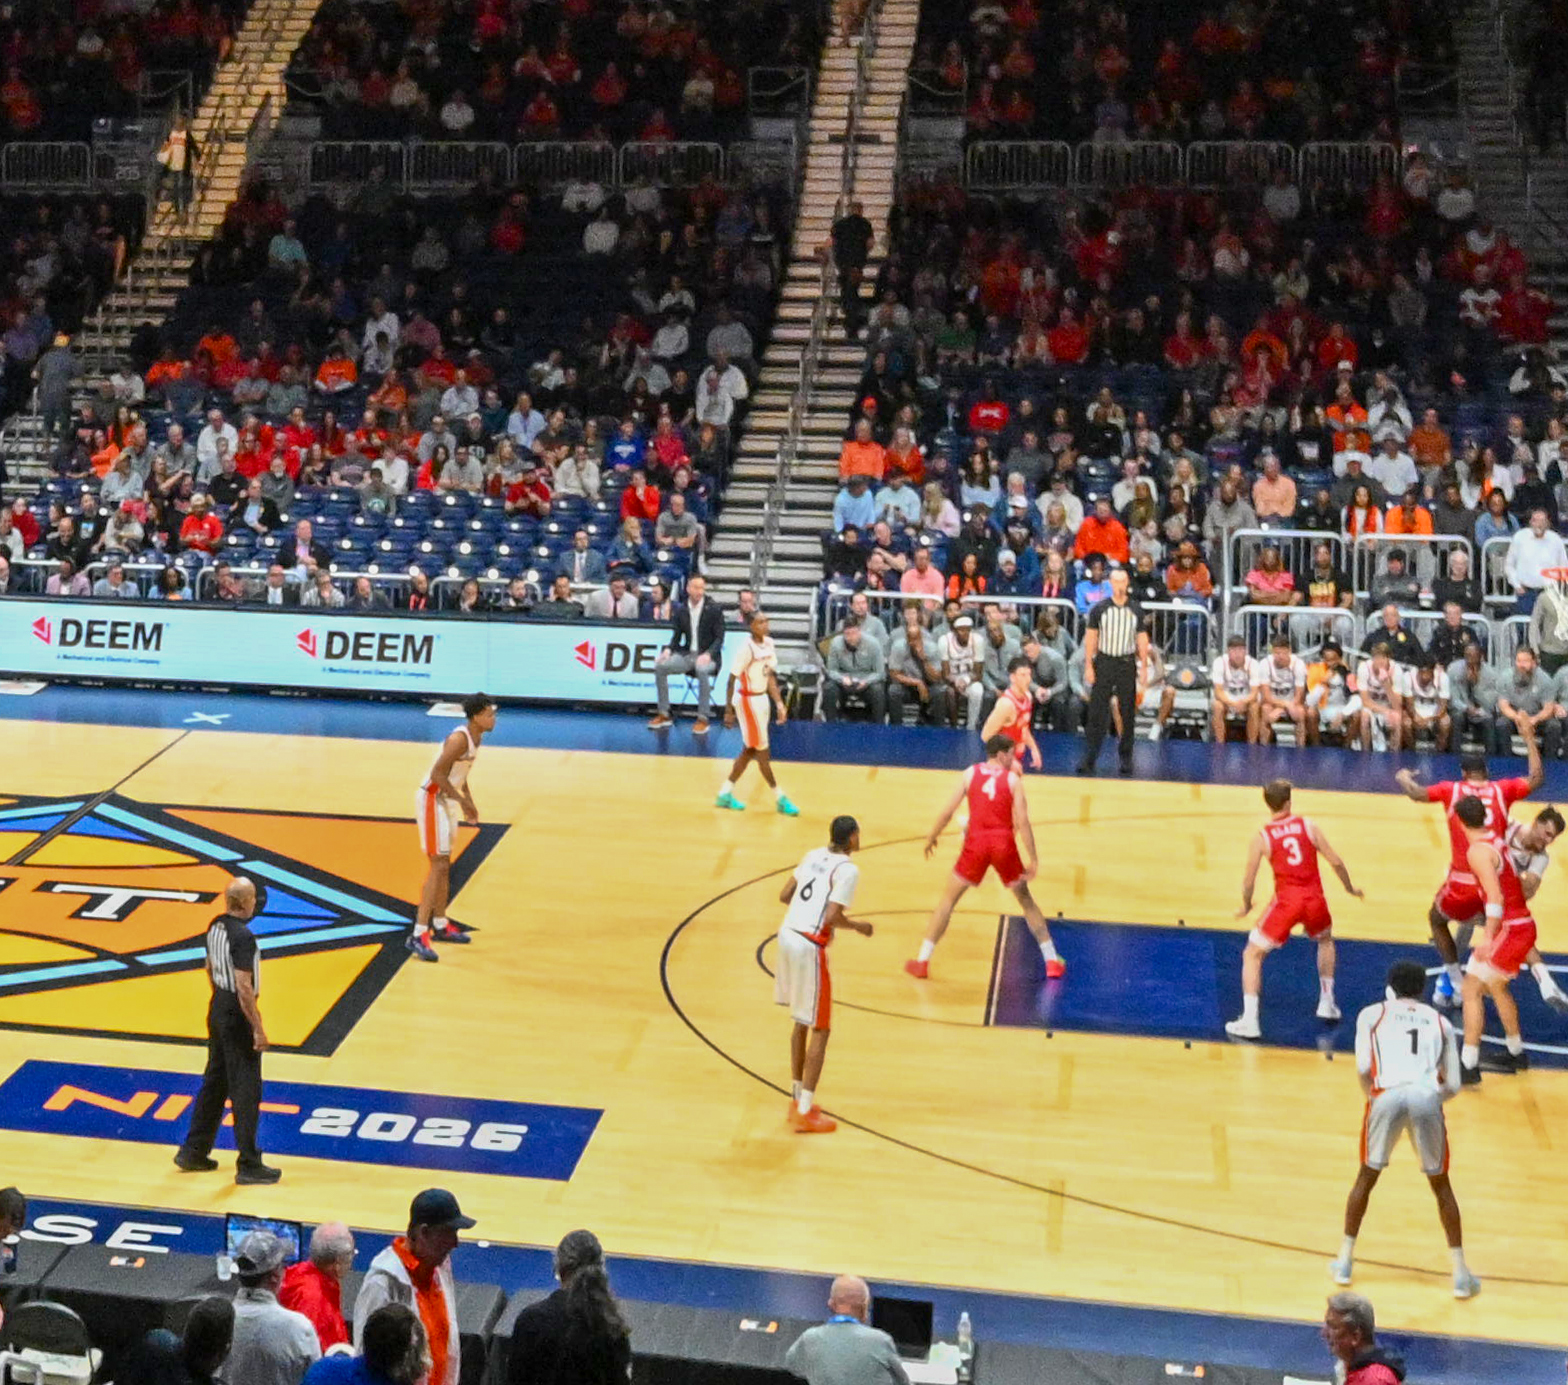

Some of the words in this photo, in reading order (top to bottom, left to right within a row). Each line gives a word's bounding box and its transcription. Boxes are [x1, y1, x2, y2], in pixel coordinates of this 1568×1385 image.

[58, 618, 163, 651] DEEM
[324, 631, 434, 664] DEEM
[982, 777, 996, 801] 4
[1282, 838, 1303, 865] 3
[800, 878, 815, 901] 6
[1406, 1028, 1418, 1055] 1
[299, 1108, 529, 1152] 2026
